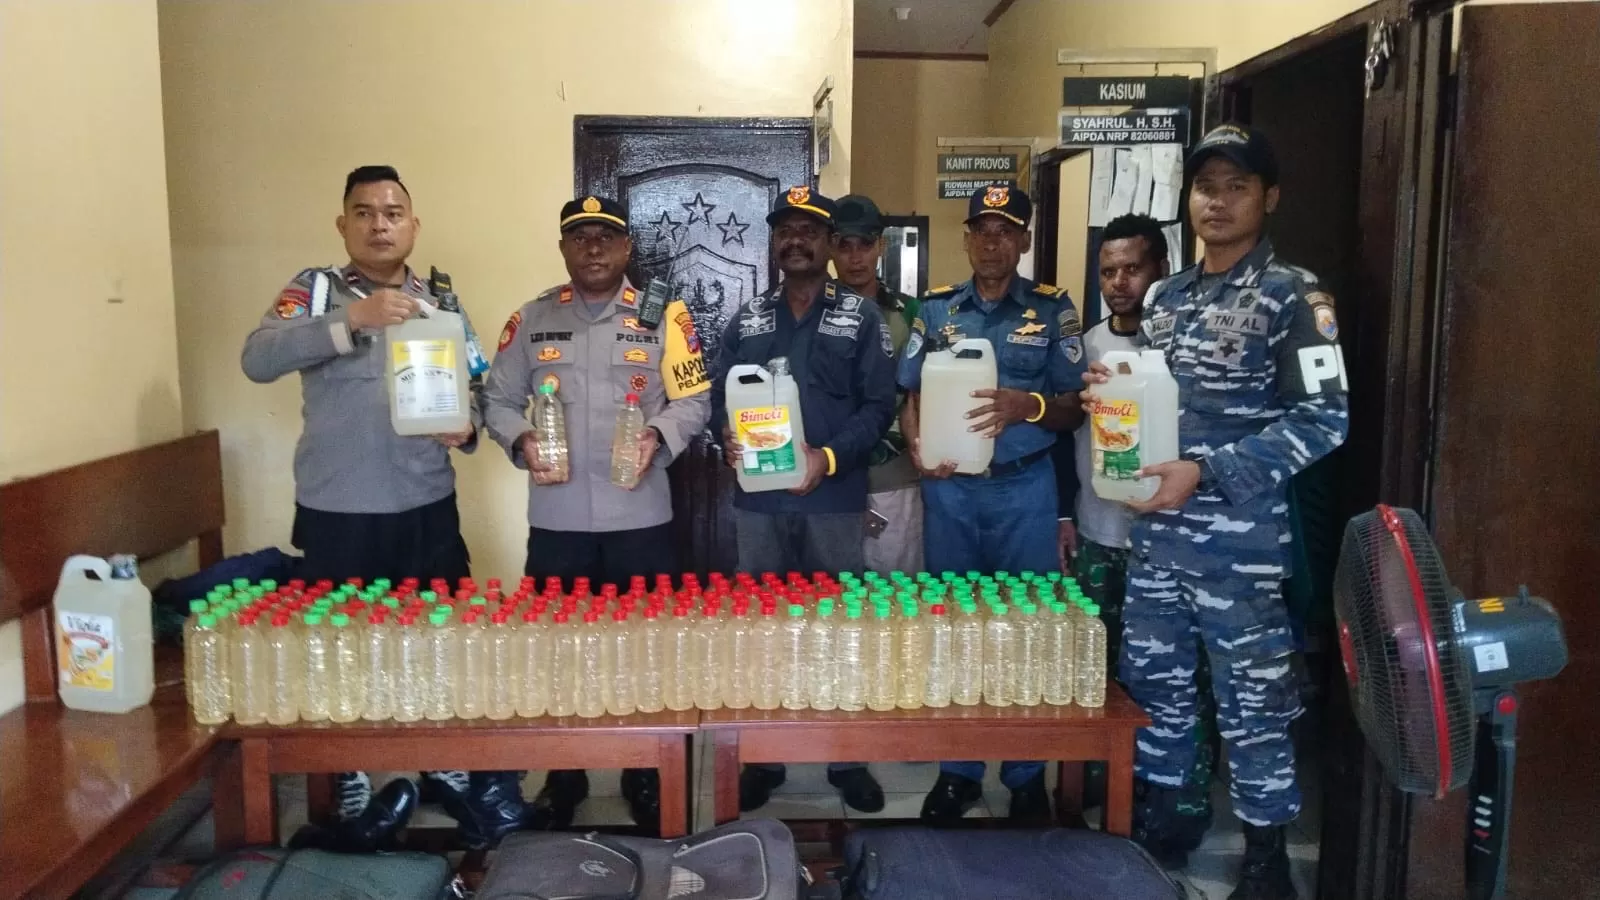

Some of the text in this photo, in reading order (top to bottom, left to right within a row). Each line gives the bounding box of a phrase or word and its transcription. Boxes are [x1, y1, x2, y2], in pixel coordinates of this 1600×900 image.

[1100, 83, 1146, 100] KASIUM
[1072, 117, 1133, 129] SYAHRUL.
[1151, 117, 1176, 129] S.H.
[1072, 131, 1105, 141] AIPDA
[1106, 131, 1129, 141] NRP
[946, 157, 1010, 170] KANIT PROVOS
[1214, 315, 1261, 331] TNI AL
[616, 333, 660, 344] POLRI
[740, 408, 783, 423] Bimoli
